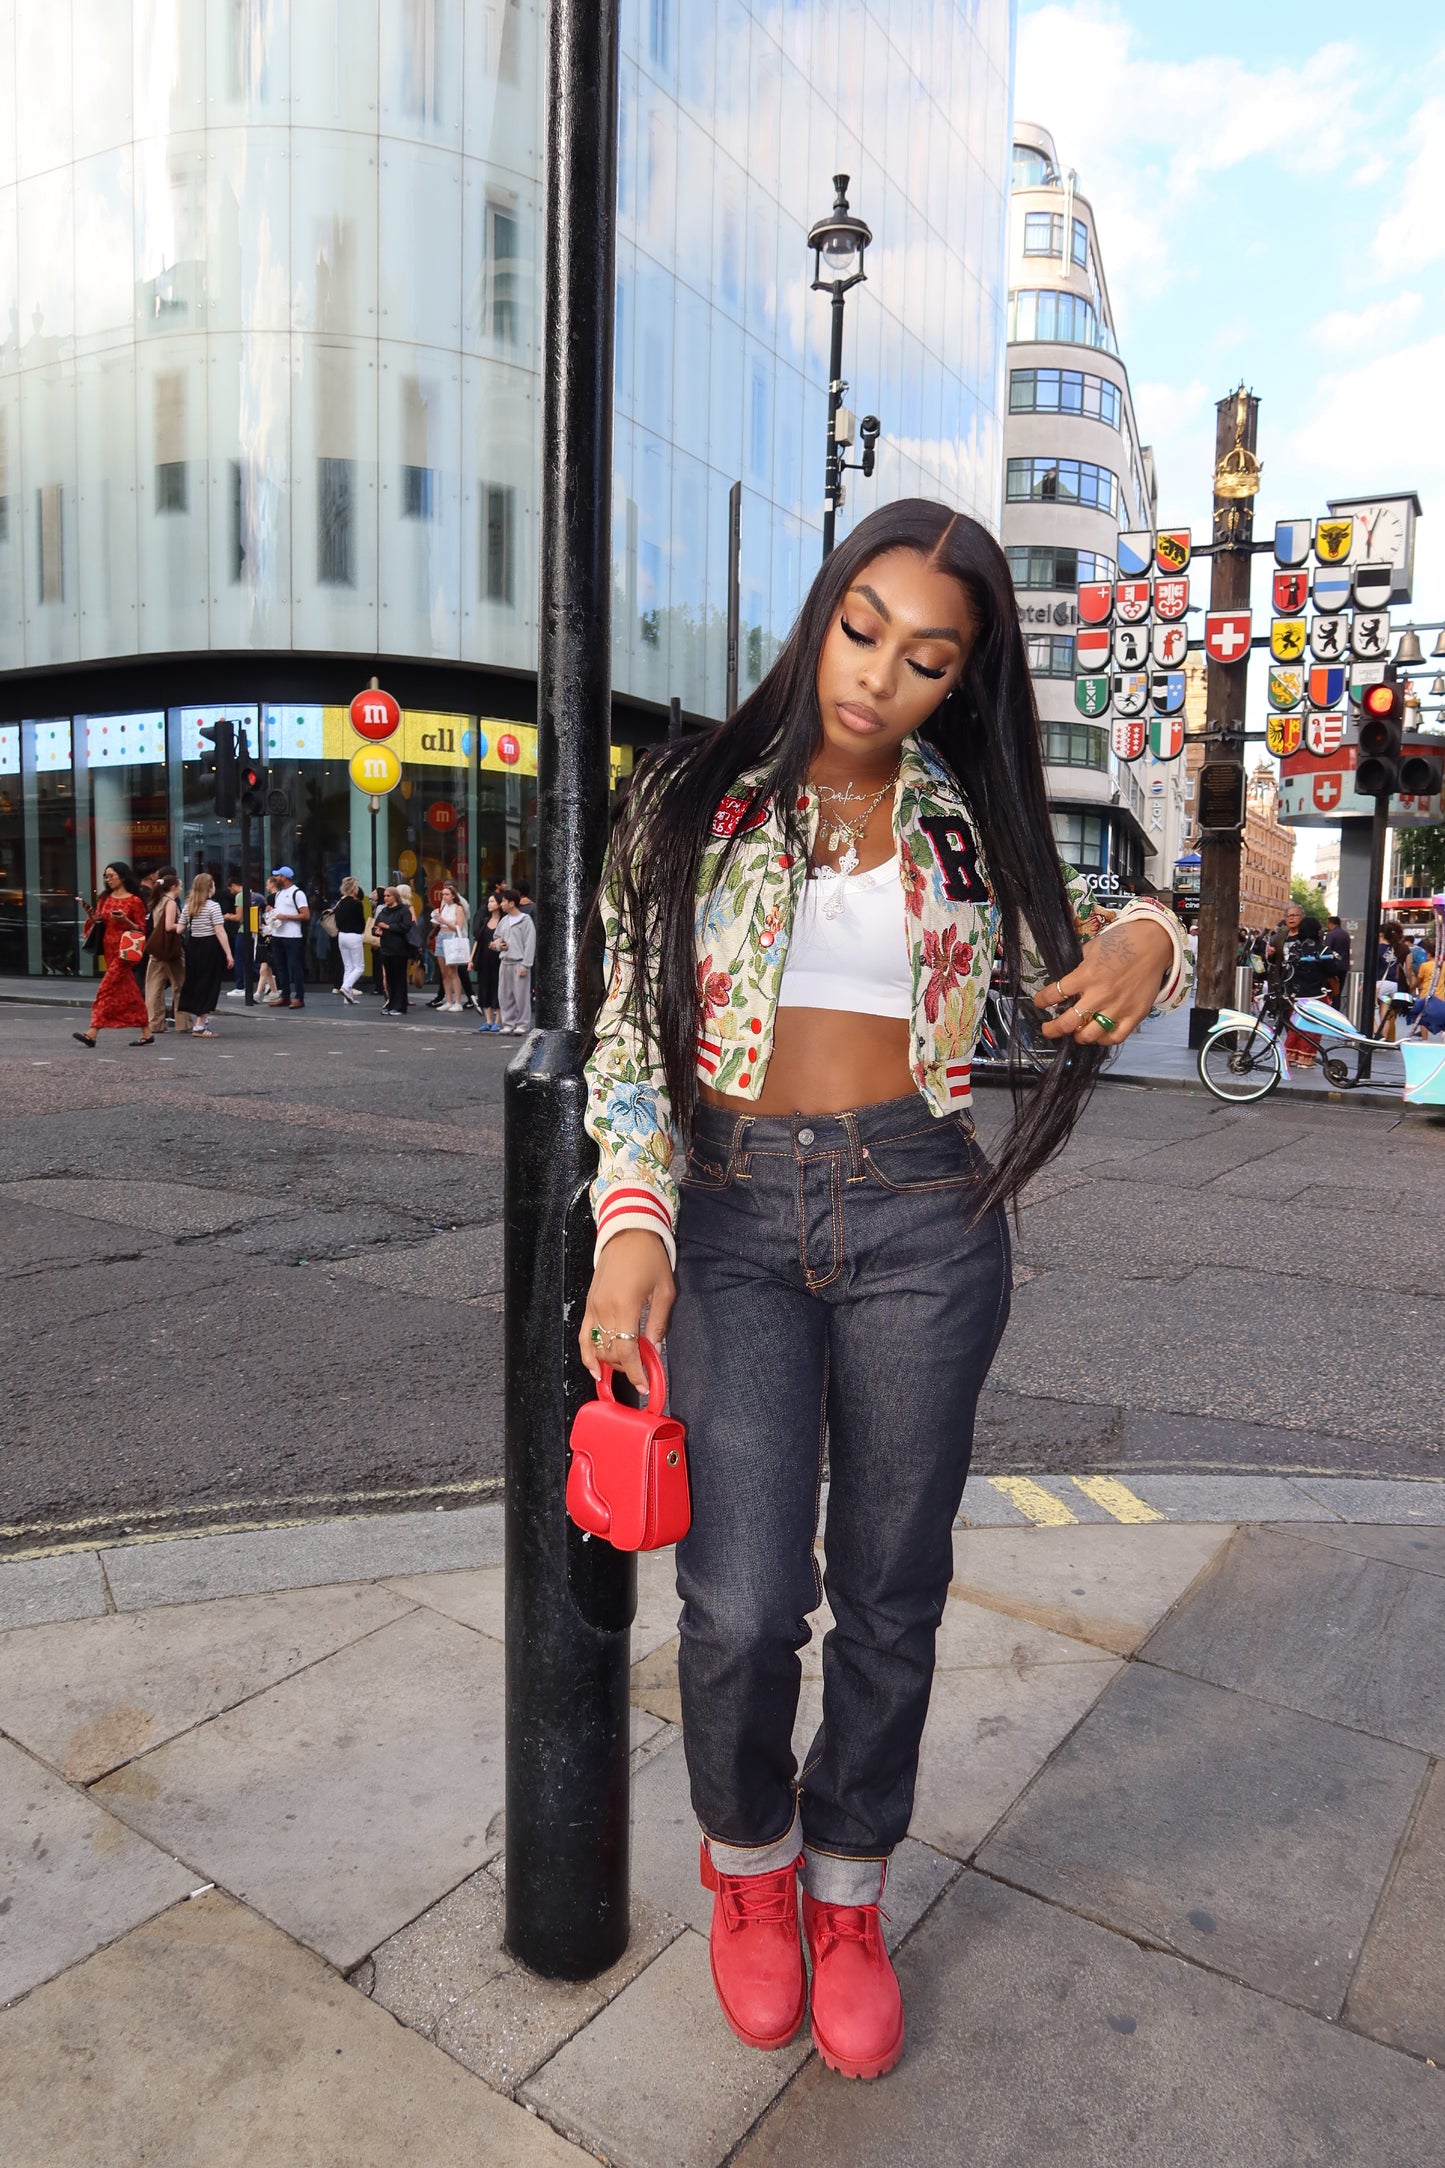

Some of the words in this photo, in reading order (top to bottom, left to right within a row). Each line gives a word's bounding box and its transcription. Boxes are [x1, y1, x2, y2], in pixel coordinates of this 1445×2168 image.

[363, 704, 389, 724] m
[421, 728, 455, 753] all
[503, 742, 515, 755] m
[363, 758, 388, 778] m
[436, 810, 449, 822] m
